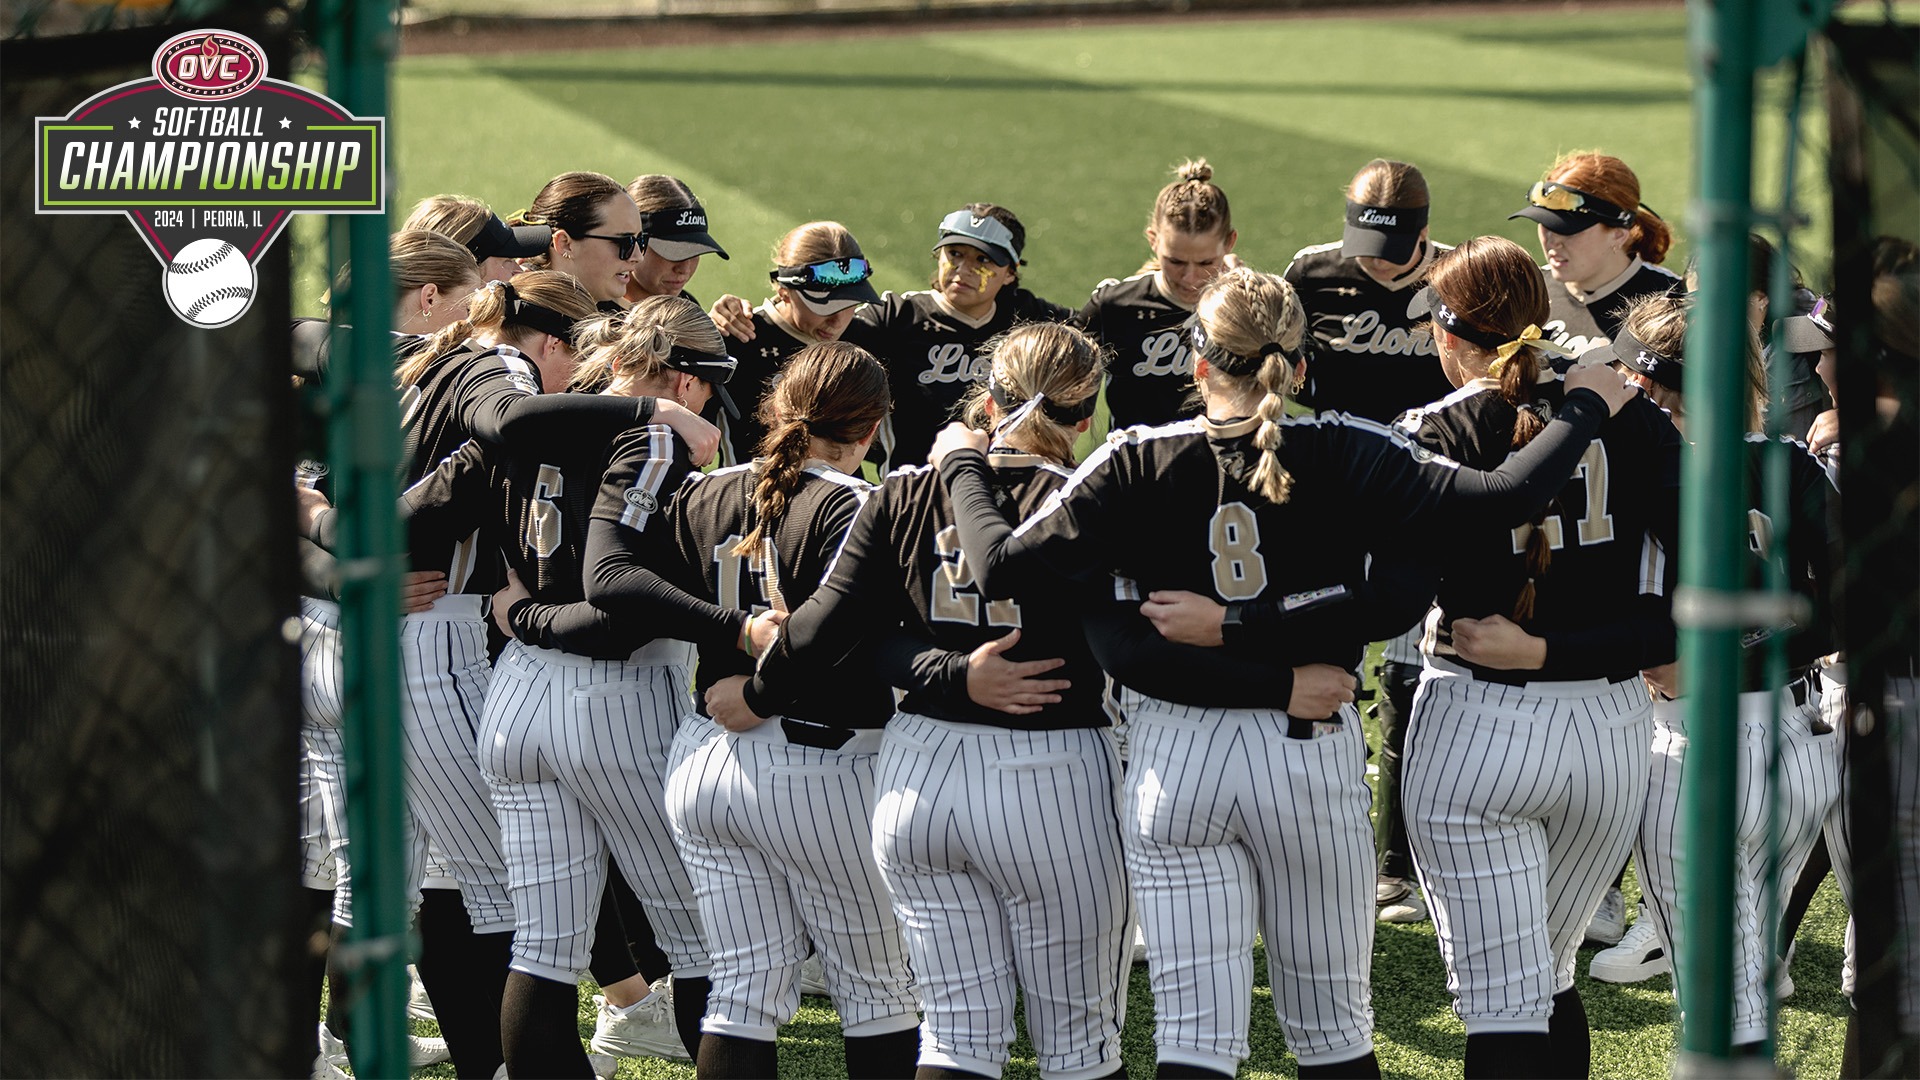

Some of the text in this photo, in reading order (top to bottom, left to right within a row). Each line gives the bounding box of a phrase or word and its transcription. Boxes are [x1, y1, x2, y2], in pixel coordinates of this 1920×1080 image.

[676, 210, 706, 226] Lions
[1358, 208, 1397, 226] Lions
[525, 463, 564, 558] 6
[1208, 501, 1268, 602] 8
